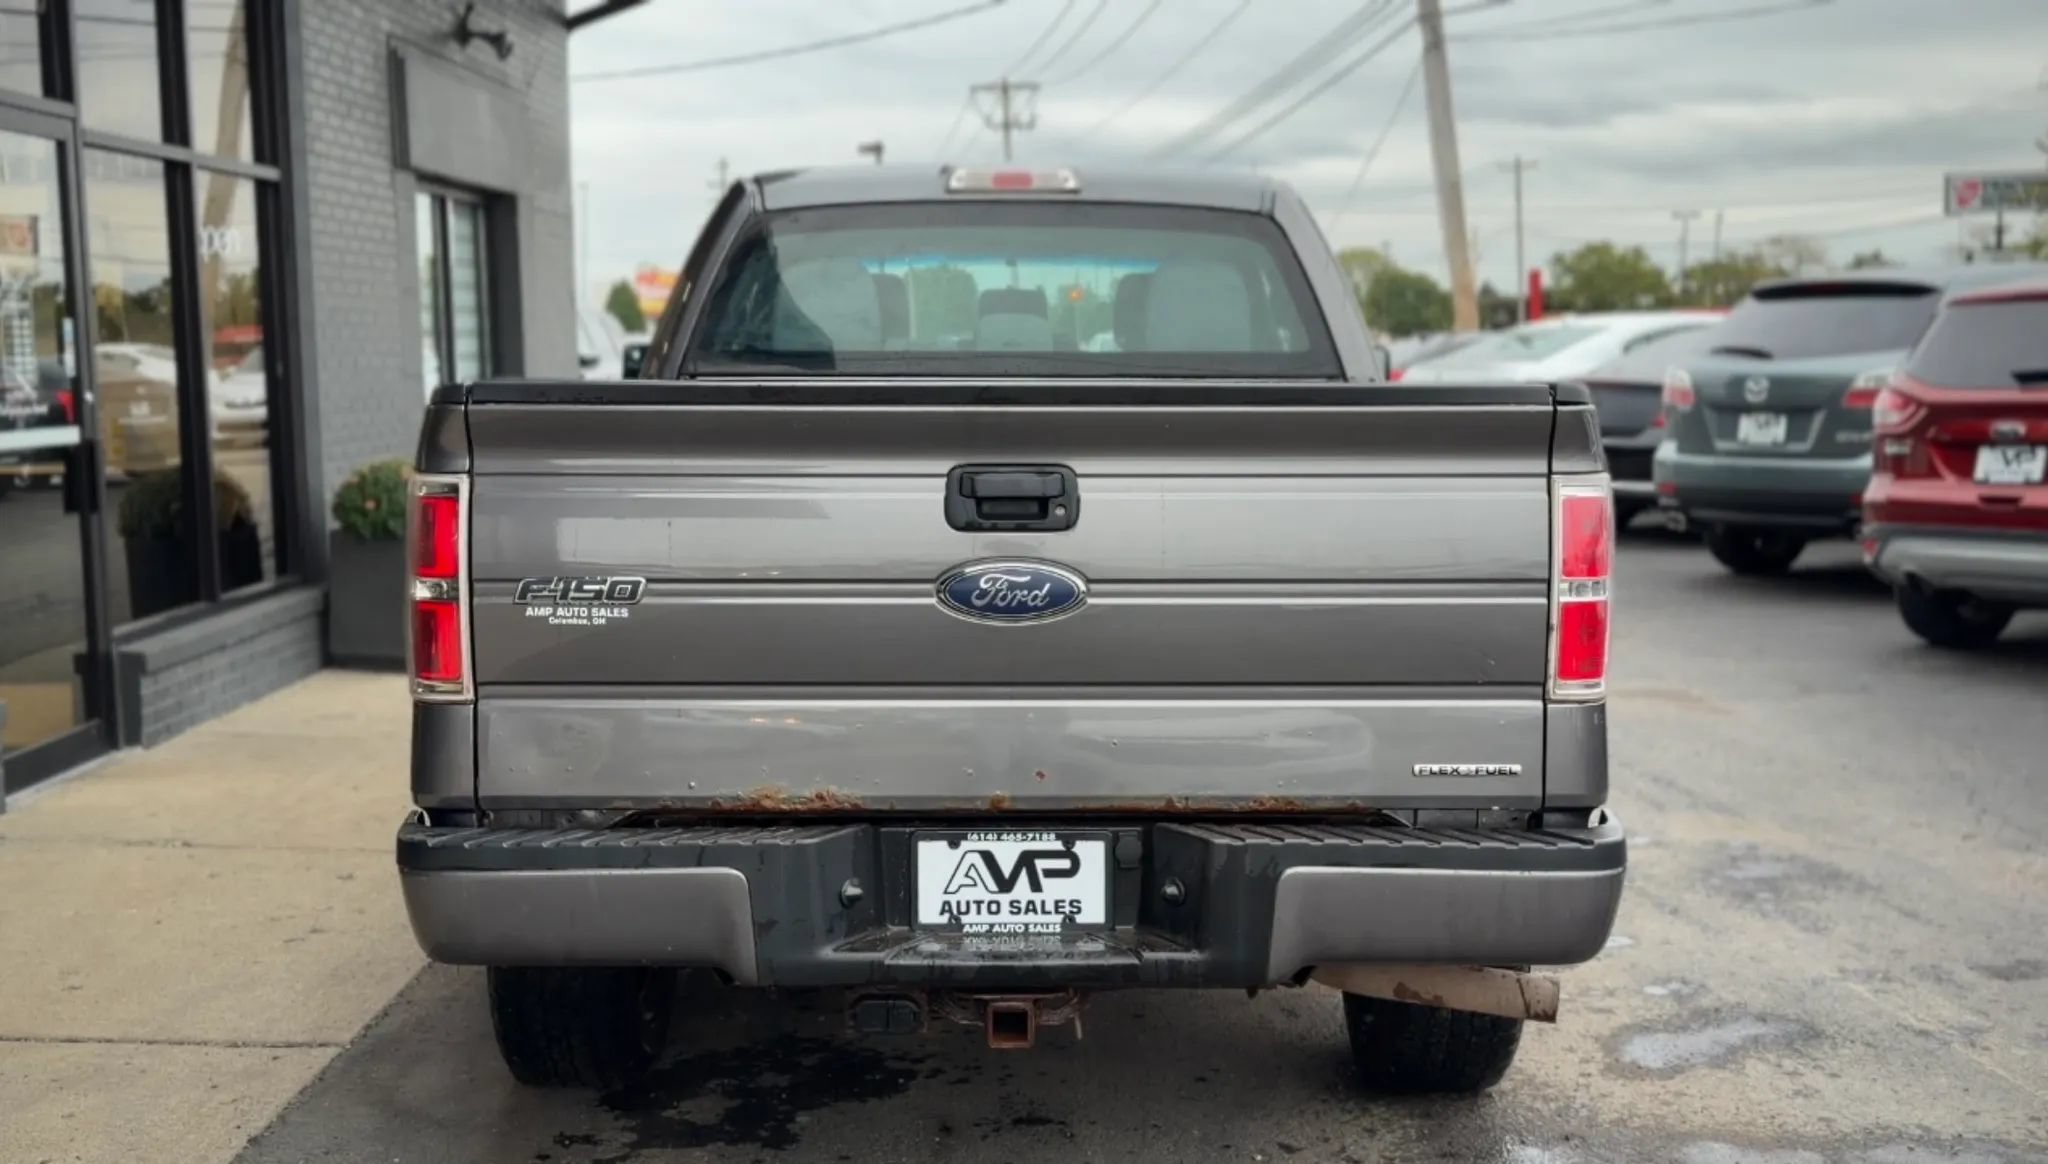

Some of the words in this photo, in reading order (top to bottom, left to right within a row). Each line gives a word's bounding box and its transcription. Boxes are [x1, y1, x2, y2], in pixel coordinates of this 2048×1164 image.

[971, 573, 1051, 607] Ford
[525, 607, 554, 617] AMP
[556, 607, 588, 617] AUTO
[591, 607, 629, 617] SALES
[1419, 766, 1460, 775] FLEX
[1475, 766, 1519, 775] FUEL
[939, 900, 1001, 916] AUTO
[1008, 900, 1082, 916] SALES
[962, 924, 990, 933] AMP
[992, 924, 1025, 933] AUTO
[1028, 924, 1061, 933] SALES
